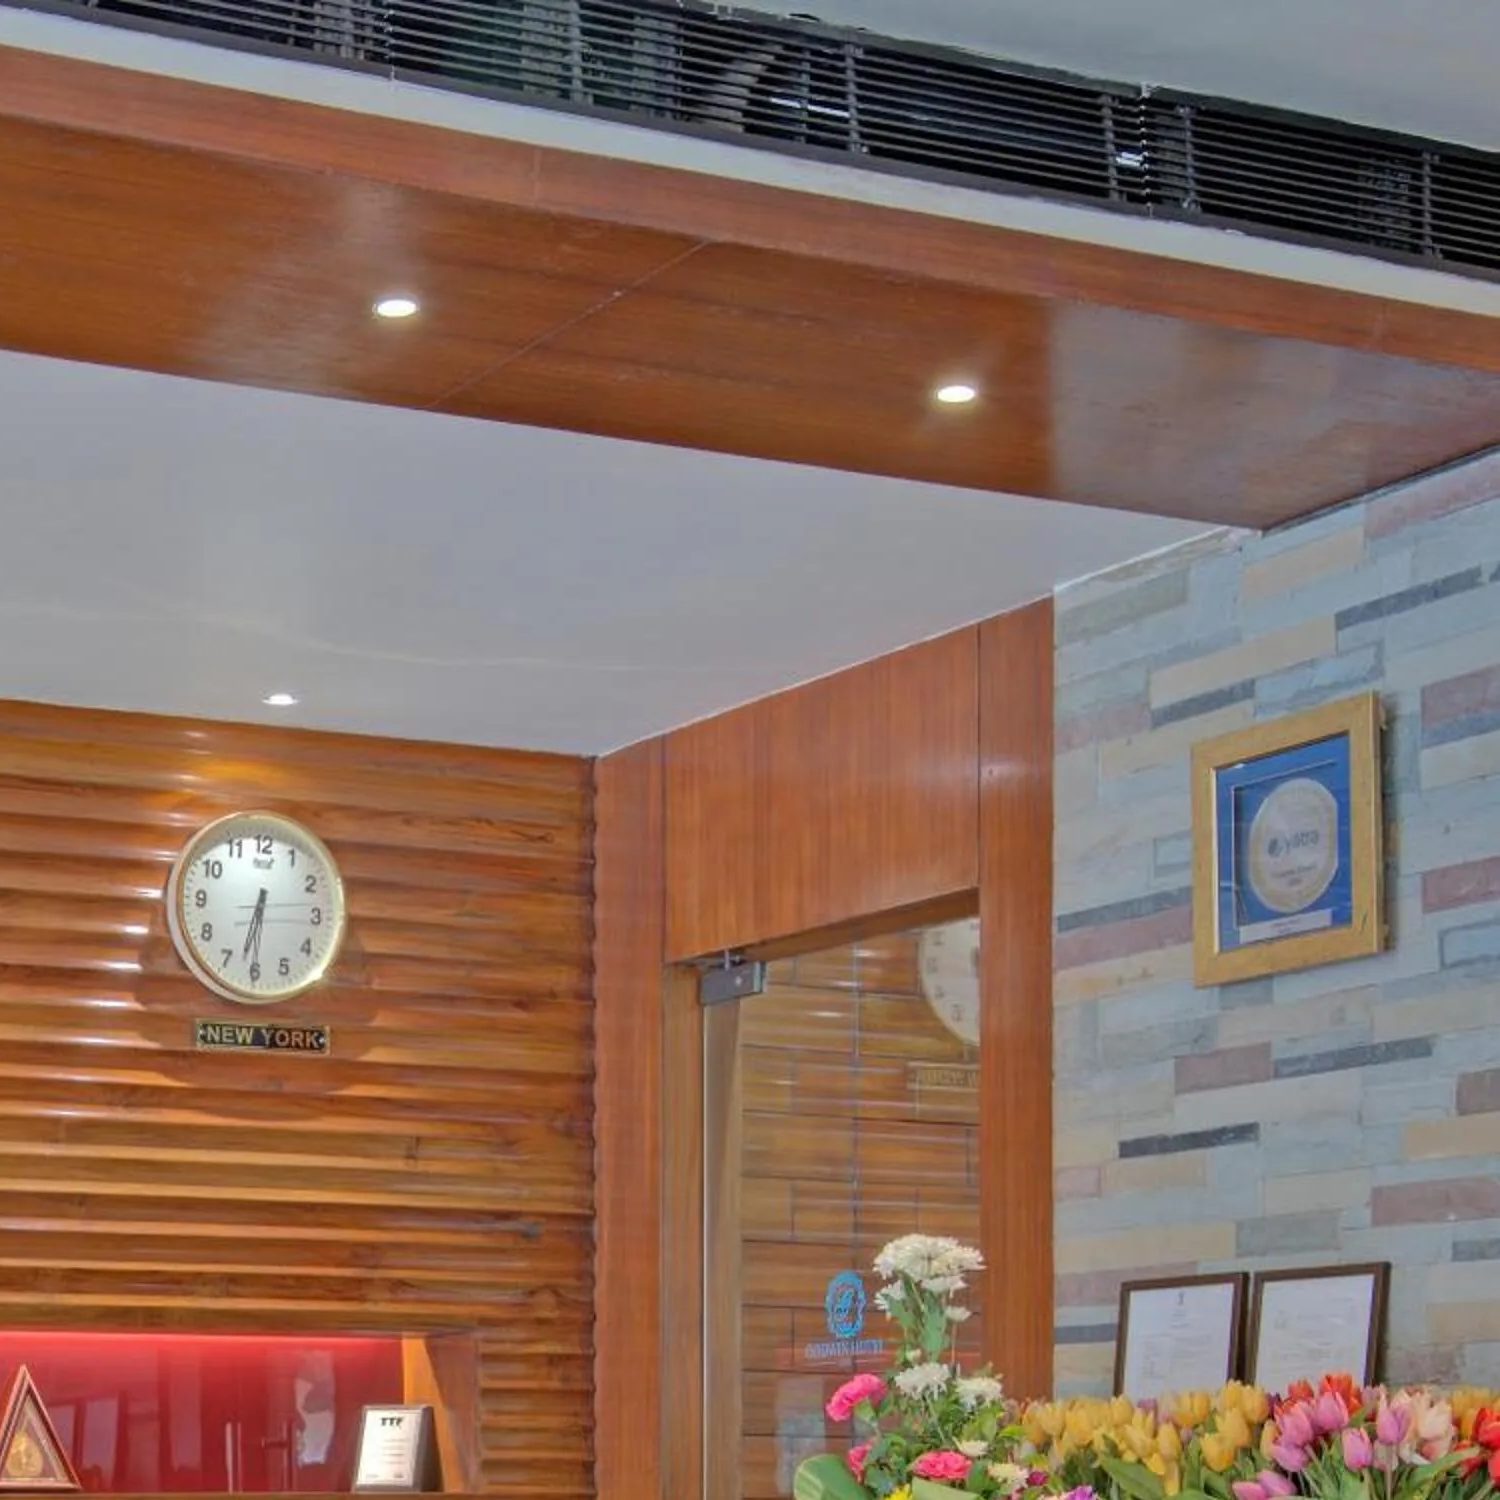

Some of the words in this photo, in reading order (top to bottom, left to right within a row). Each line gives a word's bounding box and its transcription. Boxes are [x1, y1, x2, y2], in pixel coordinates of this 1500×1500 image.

[228, 840, 243, 859] 11
[254, 835, 273, 855] 12
[288, 849, 296, 867] 1
[203, 860, 223, 879] 10
[305, 875, 316, 893] 2
[196, 890, 207, 907] 9
[311, 907, 321, 925] 3
[201, 923, 213, 941] 8
[301, 938, 312, 955] 4
[221, 949, 233, 967] 7
[278, 958, 290, 976] 5
[249, 963, 261, 981] 6
[206, 1025, 254, 1044] NEW
[261, 1029, 319, 1048] YORK
